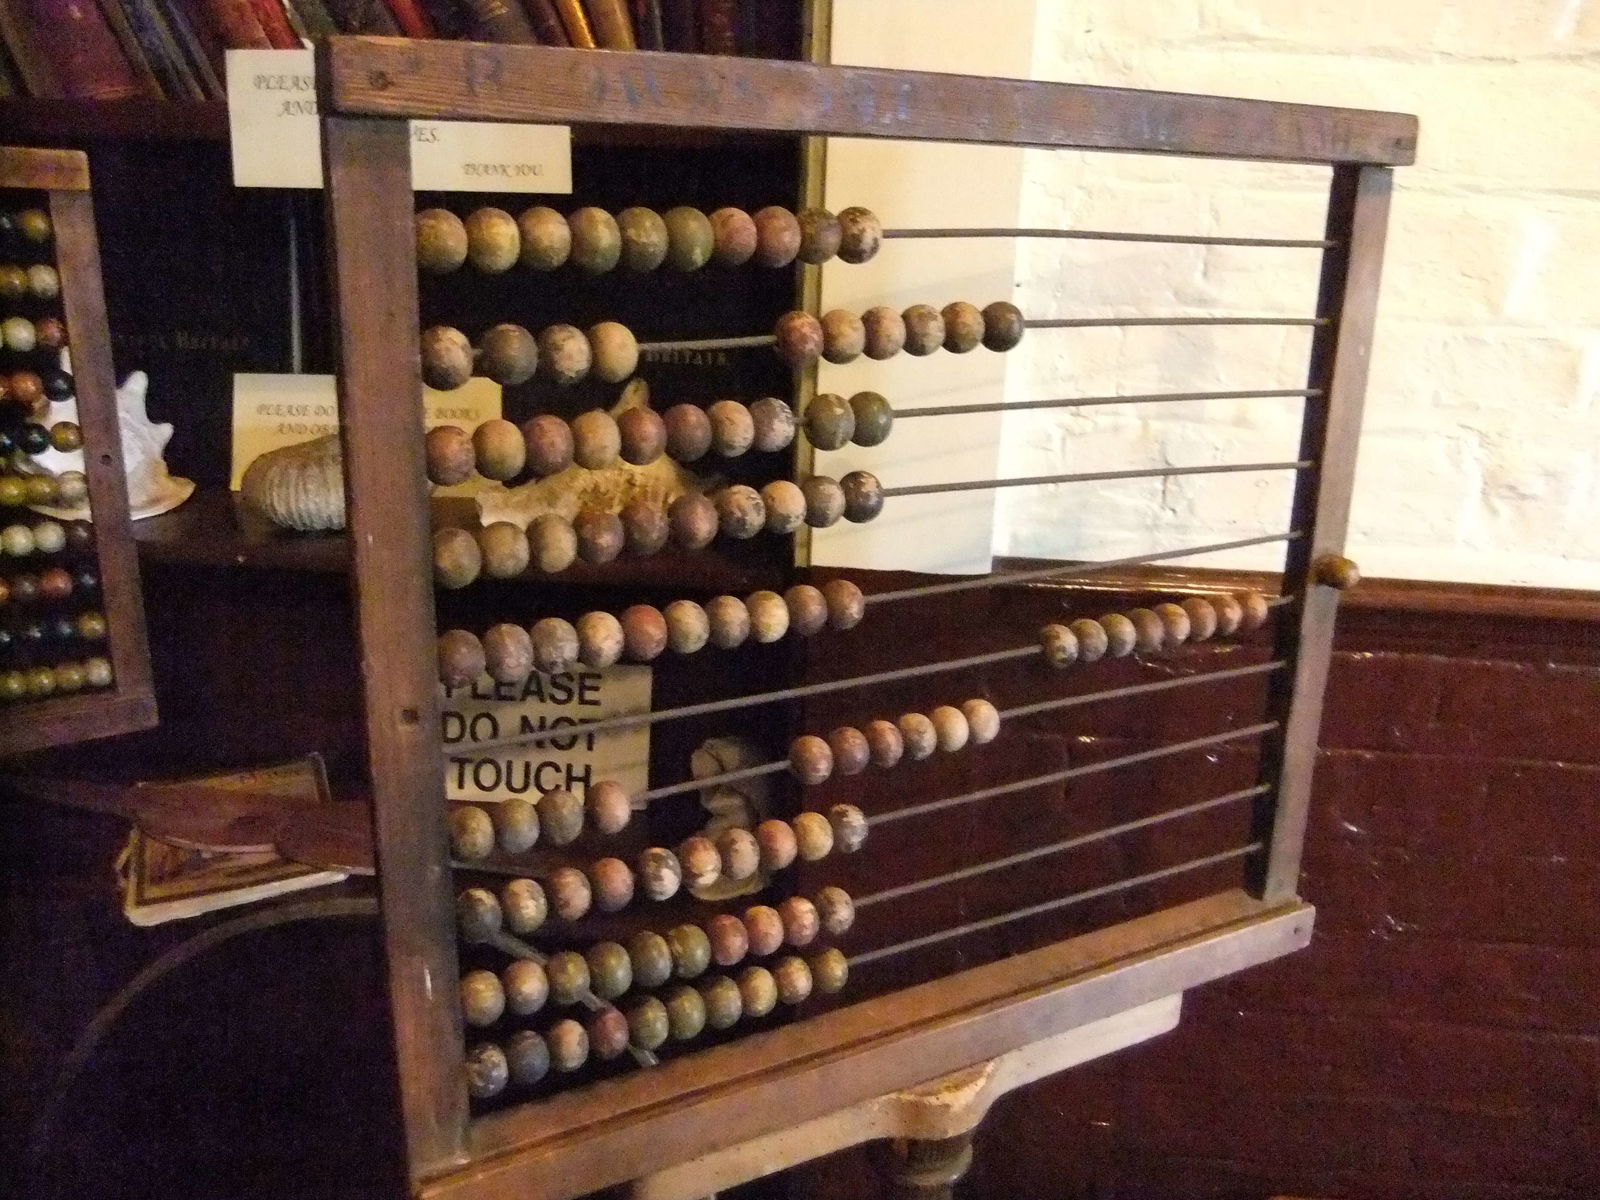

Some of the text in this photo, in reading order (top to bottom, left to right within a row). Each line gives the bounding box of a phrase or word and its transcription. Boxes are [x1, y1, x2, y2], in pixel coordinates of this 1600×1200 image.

[253, 74, 317, 92] PLEAS
[256, 403, 311, 417] PLEASE
[442, 710, 600, 752] DO NOT
[450, 756, 592, 796] TOUCH
